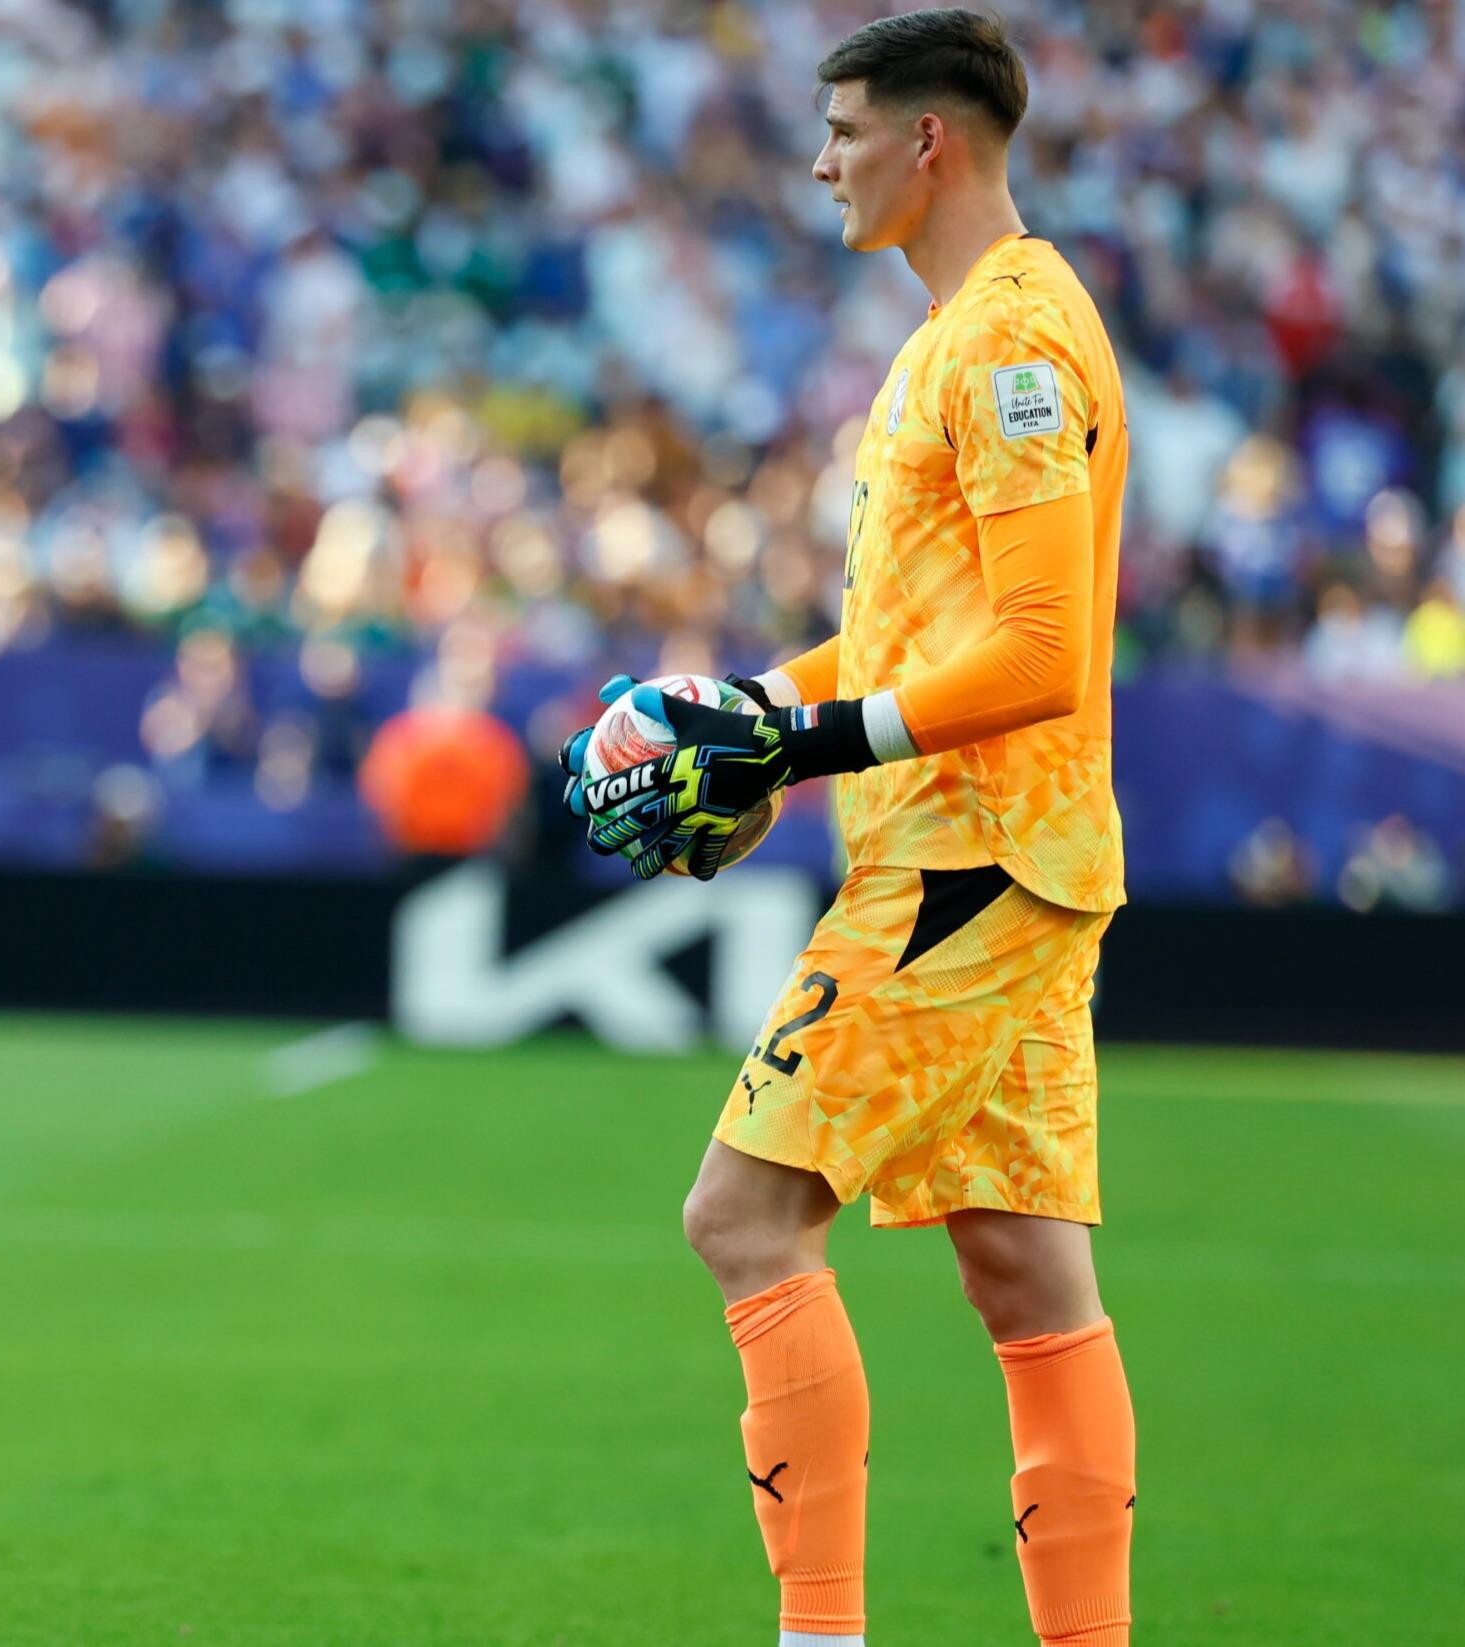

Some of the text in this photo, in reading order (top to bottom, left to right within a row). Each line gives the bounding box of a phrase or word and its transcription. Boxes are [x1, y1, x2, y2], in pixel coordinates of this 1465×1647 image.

[1009, 406, 1052, 423] EDUCATION
[843, 480, 868, 589] 2
[586, 762, 655, 811] Voit
[753, 970, 839, 1077] 2
